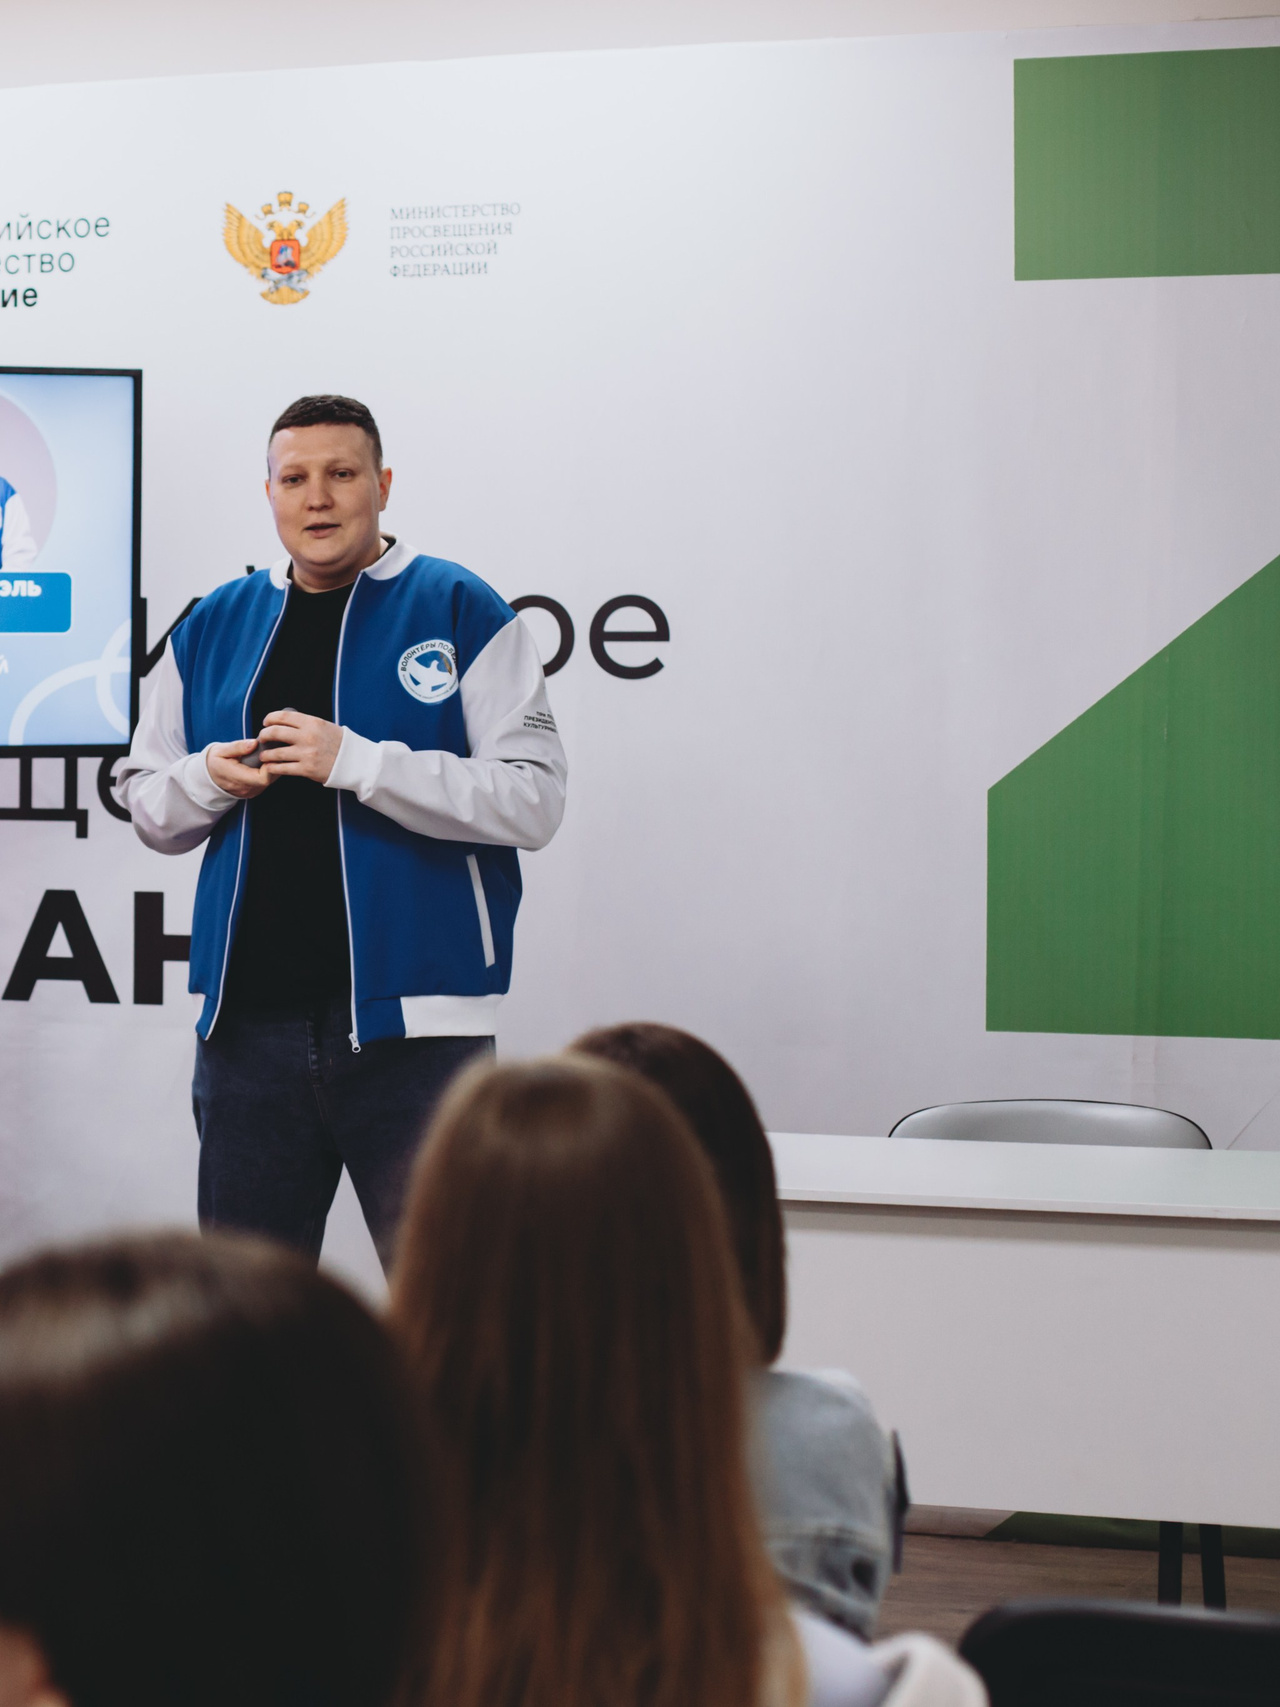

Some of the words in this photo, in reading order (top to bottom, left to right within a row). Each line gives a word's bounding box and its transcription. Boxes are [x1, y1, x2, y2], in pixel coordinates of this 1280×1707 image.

[390, 202, 521, 219] МИНИСТЕРСТВО
[390, 222, 513, 240] ПРОСВЕЩЕНИЯ
[390, 239, 498, 258] РОССИЙСКОЙ
[389, 261, 488, 277] ФЕДЕРАЦИИ
[401, 642, 436, 672] ВОЛОНТЕРЫ
[438, 642, 457, 664] ПОБЕ
